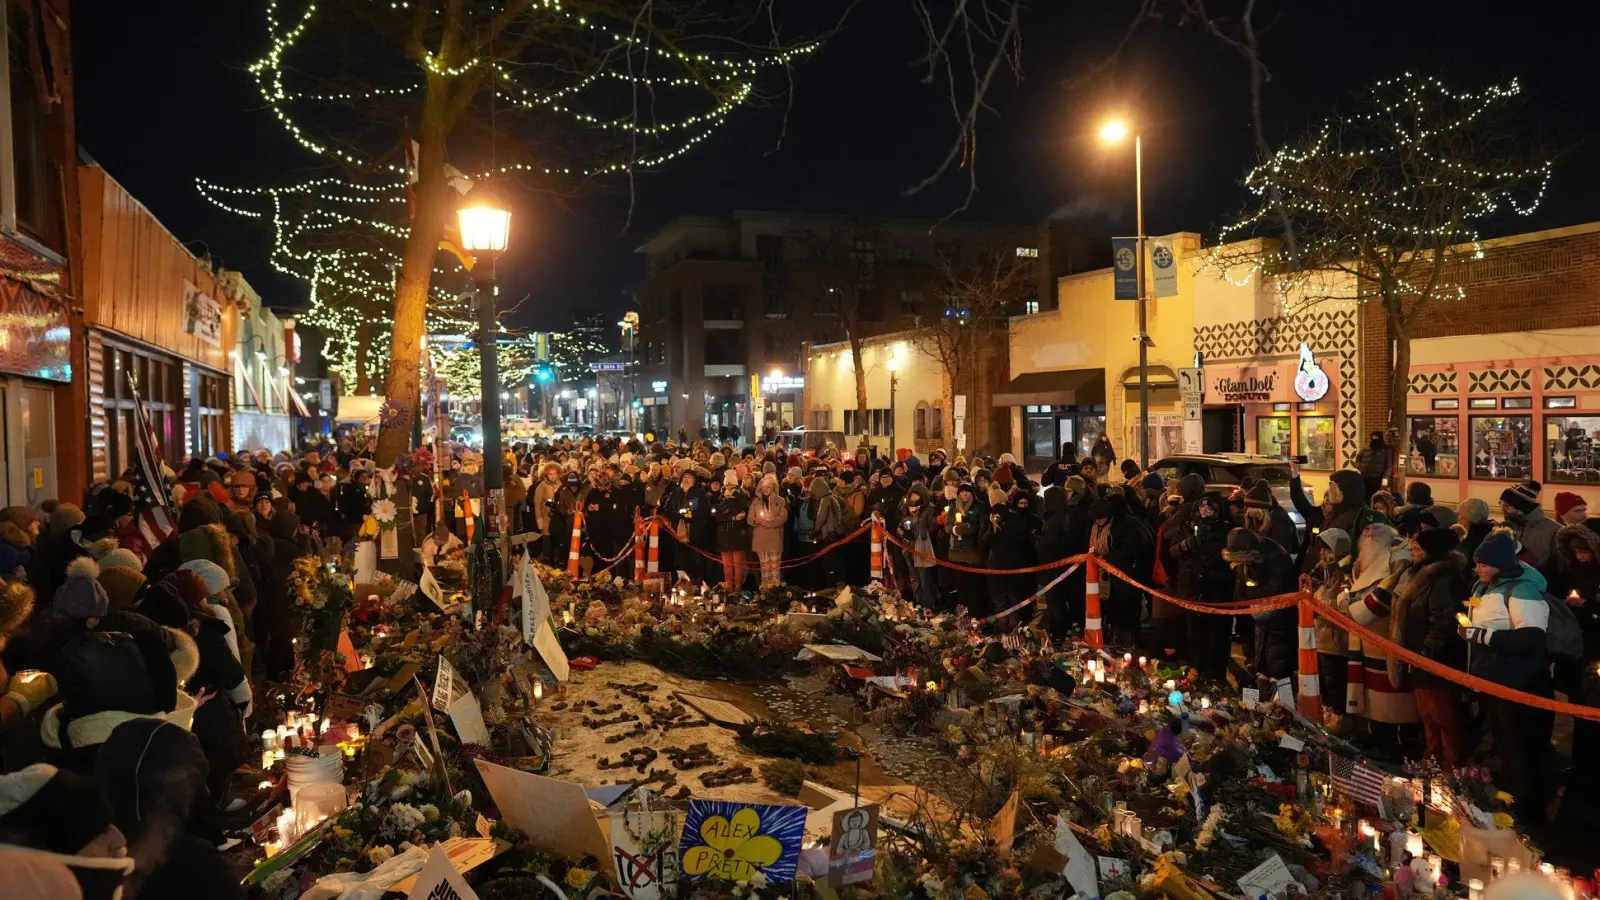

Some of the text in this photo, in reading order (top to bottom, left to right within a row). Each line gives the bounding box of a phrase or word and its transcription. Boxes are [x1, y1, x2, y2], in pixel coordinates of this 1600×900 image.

[1219, 375, 1275, 393] Glam Doll
[1224, 393, 1271, 401] DONUTS
[706, 821, 754, 839] ALEX
